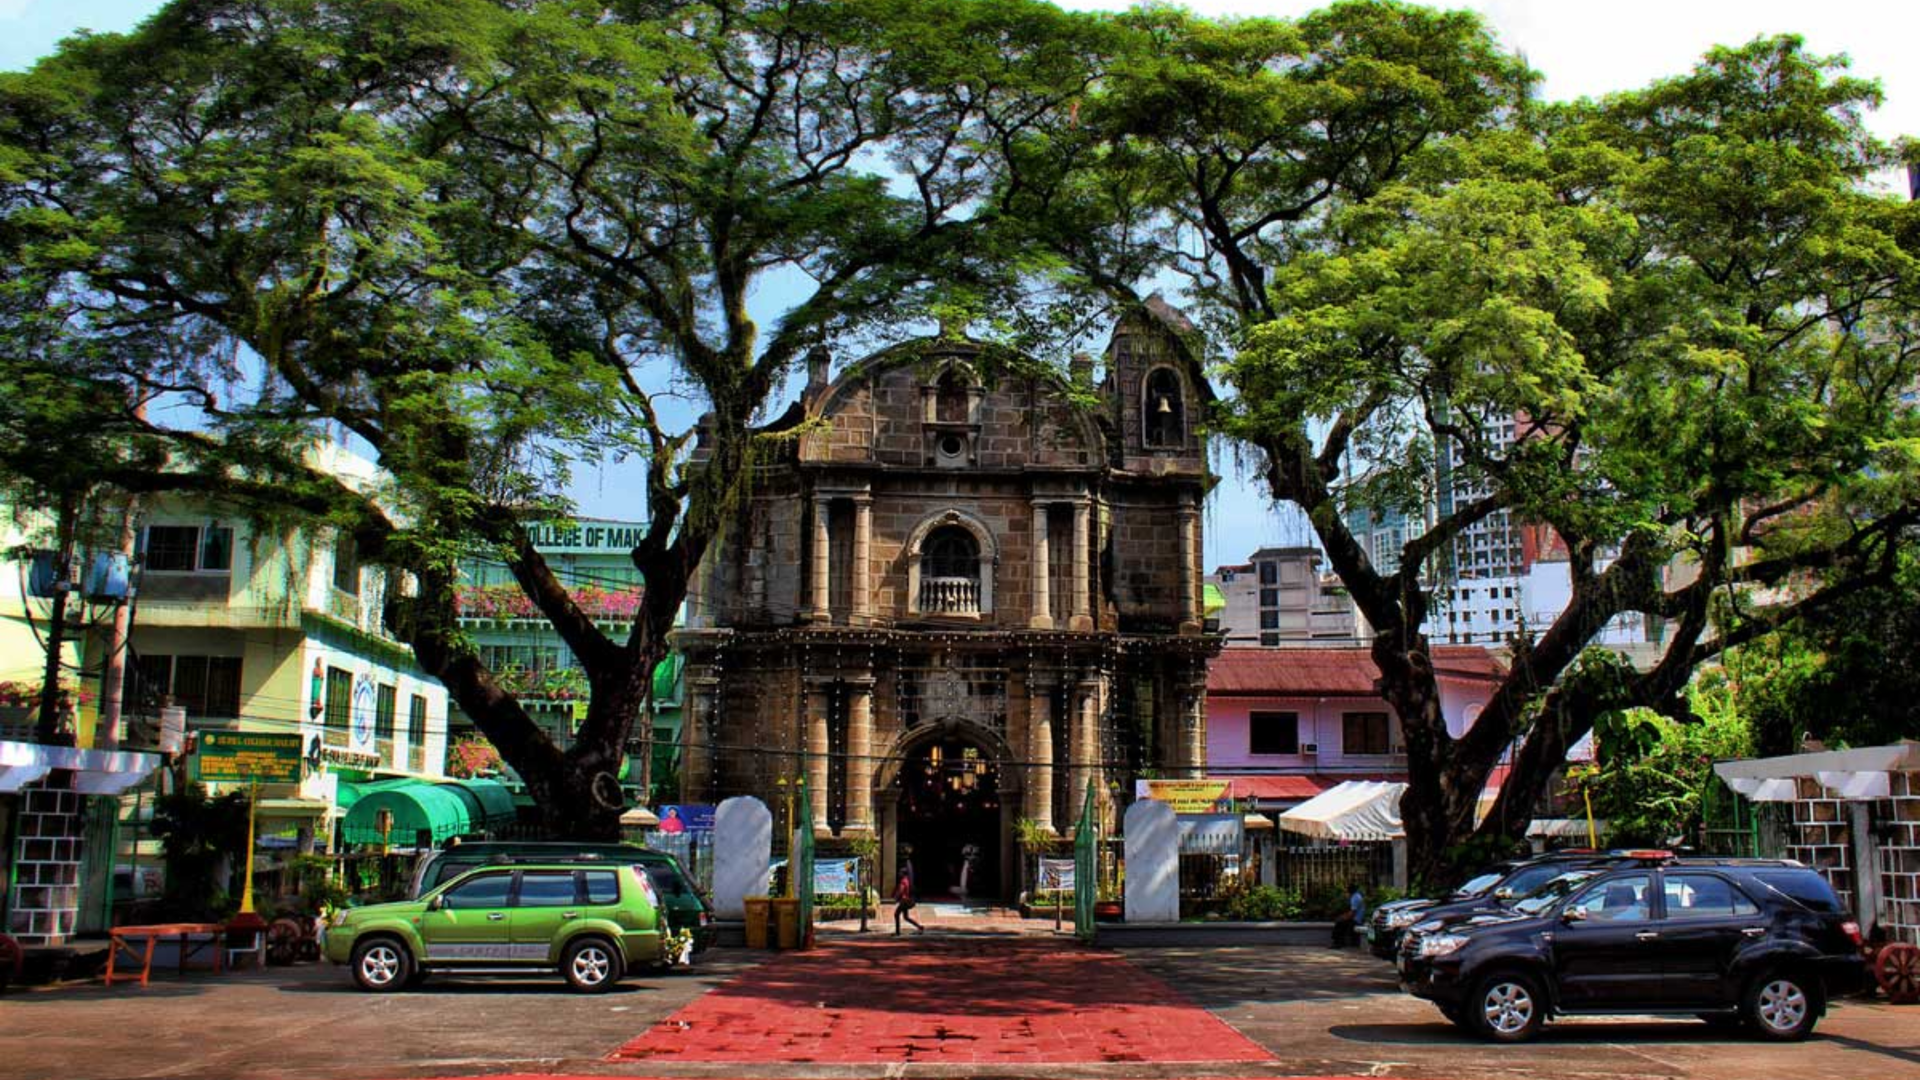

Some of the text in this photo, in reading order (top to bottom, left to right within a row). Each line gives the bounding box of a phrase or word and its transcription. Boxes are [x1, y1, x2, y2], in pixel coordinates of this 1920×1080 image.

[527, 526, 649, 548] OLLEGE OF MAK
